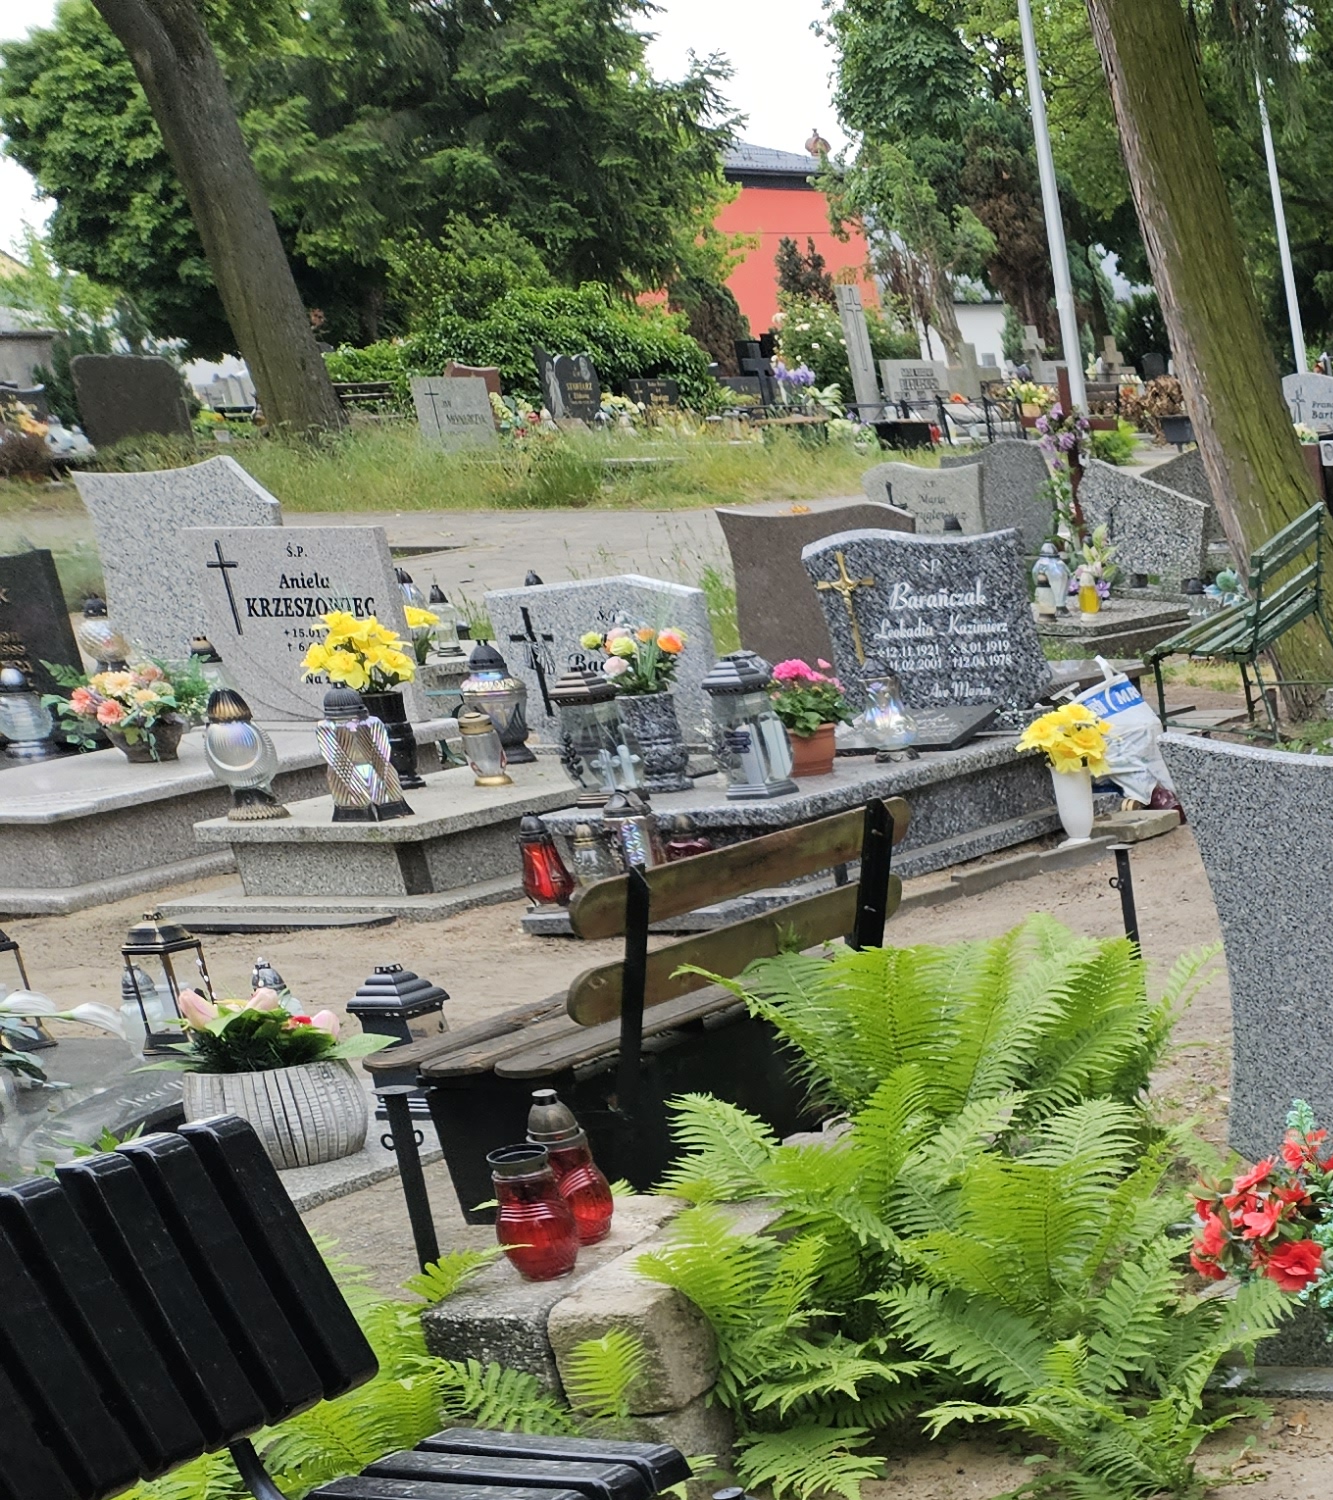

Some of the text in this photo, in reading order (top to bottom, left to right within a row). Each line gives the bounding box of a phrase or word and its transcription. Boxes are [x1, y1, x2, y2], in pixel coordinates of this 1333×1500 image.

[286, 542, 308, 558] Ś.P.
[279, 572, 330, 589] Aniela
[888, 578, 987, 610] Barańczak
[873, 613, 1008, 640] Leokadia Kazimierz
[952, 680, 992, 698] Maria
